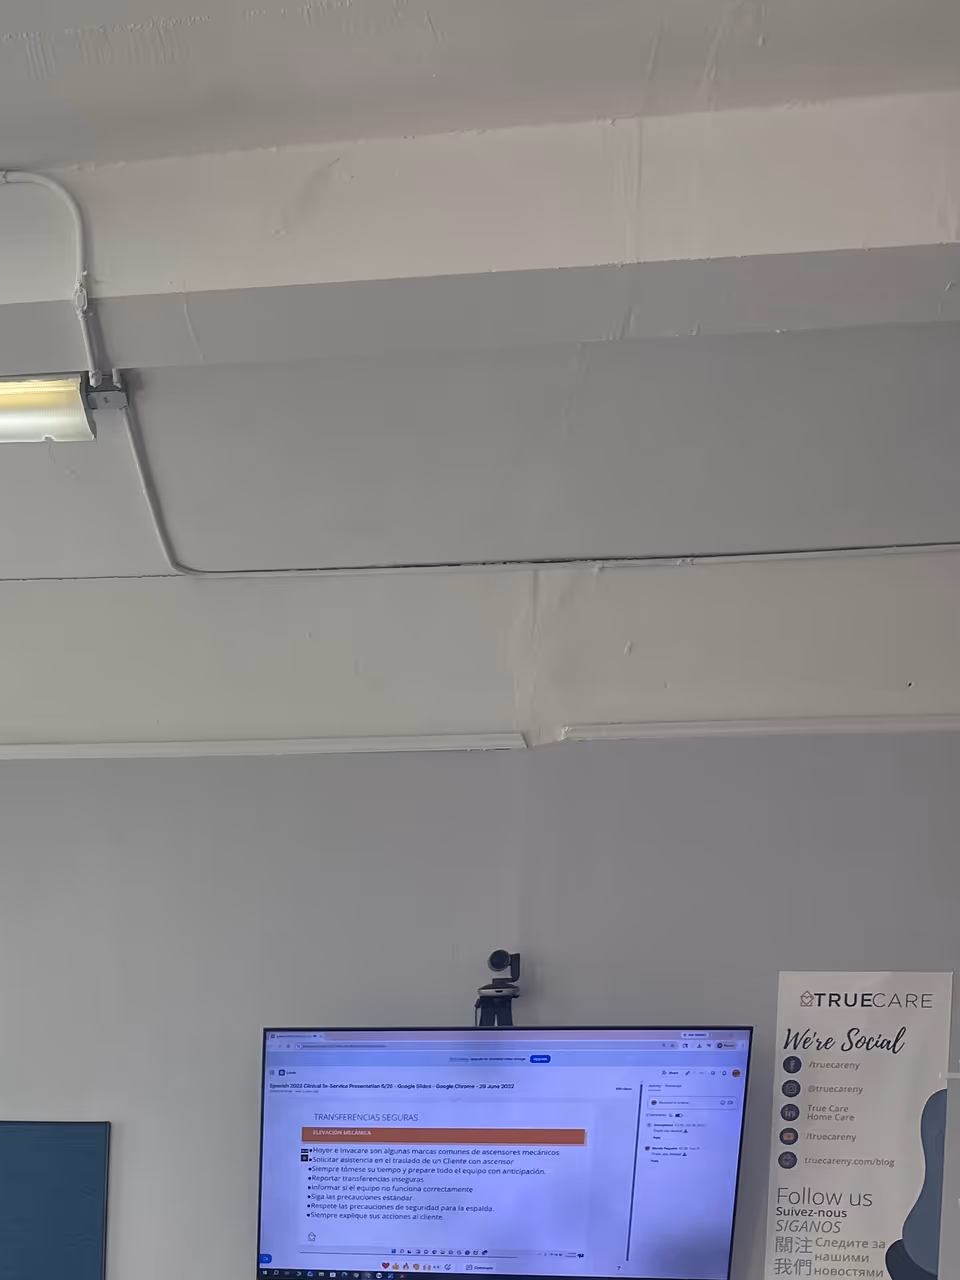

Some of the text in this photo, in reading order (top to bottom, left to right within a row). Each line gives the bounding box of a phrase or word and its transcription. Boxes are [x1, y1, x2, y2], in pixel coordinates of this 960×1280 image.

[814, 993, 933, 1009] TRUECARE
[783, 1027, 907, 1054] We're Social
[809, 1061, 860, 1071] /truecareny
[808, 1085, 864, 1095] @truecareny
[807, 1105, 827, 1113] True
[314, 1113, 380, 1121] TRANSFERENCIAS
[835, 1114, 855, 1122] Care
[806, 1133, 857, 1142] /truecareny
[313, 1147, 334, 1155] Hoyer
[384, 1148, 410, 1156] algunas
[805, 1157, 895, 1168] truecareny.com/blog
[777, 1187, 873, 1207] Follow us
[406, 1204, 439, 1212] seguridad
[776, 1207, 848, 1218] Suivez-nous
[776, 1220, 842, 1234] SIGANOS
[775, 1236, 813, 1254] 關注
[815, 1237, 886, 1250] Следите за
[815, 1253, 870, 1263] нашими
[774, 1258, 812, 1276] 我們
[814, 1267, 884, 1278] новостями
